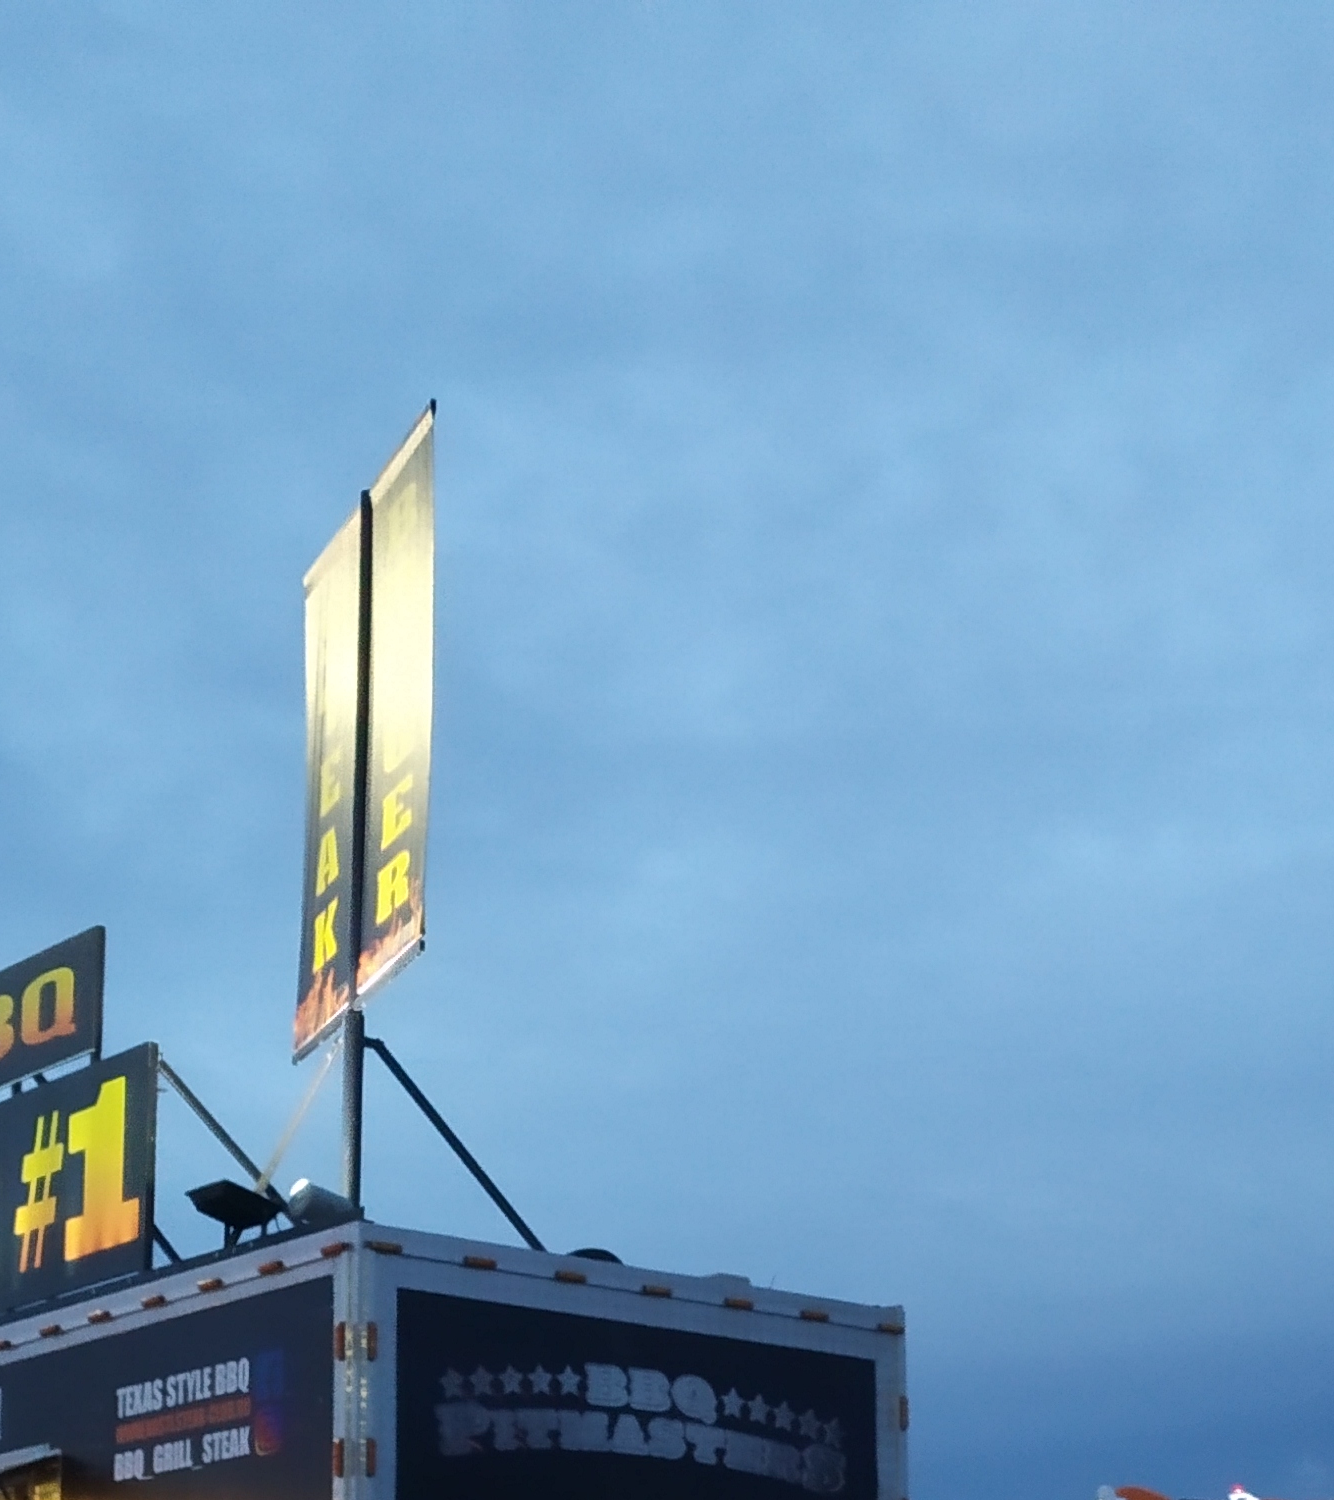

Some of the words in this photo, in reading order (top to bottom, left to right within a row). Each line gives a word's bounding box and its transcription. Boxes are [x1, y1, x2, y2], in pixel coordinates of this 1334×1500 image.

[13, 1076, 141, 1273] #1
[116, 1378, 163, 1419] TEXAS
[165, 1366, 212, 1408] STYLE
[214, 1357, 250, 1394] BBQ
[583, 1361, 718, 1425] BBQ
